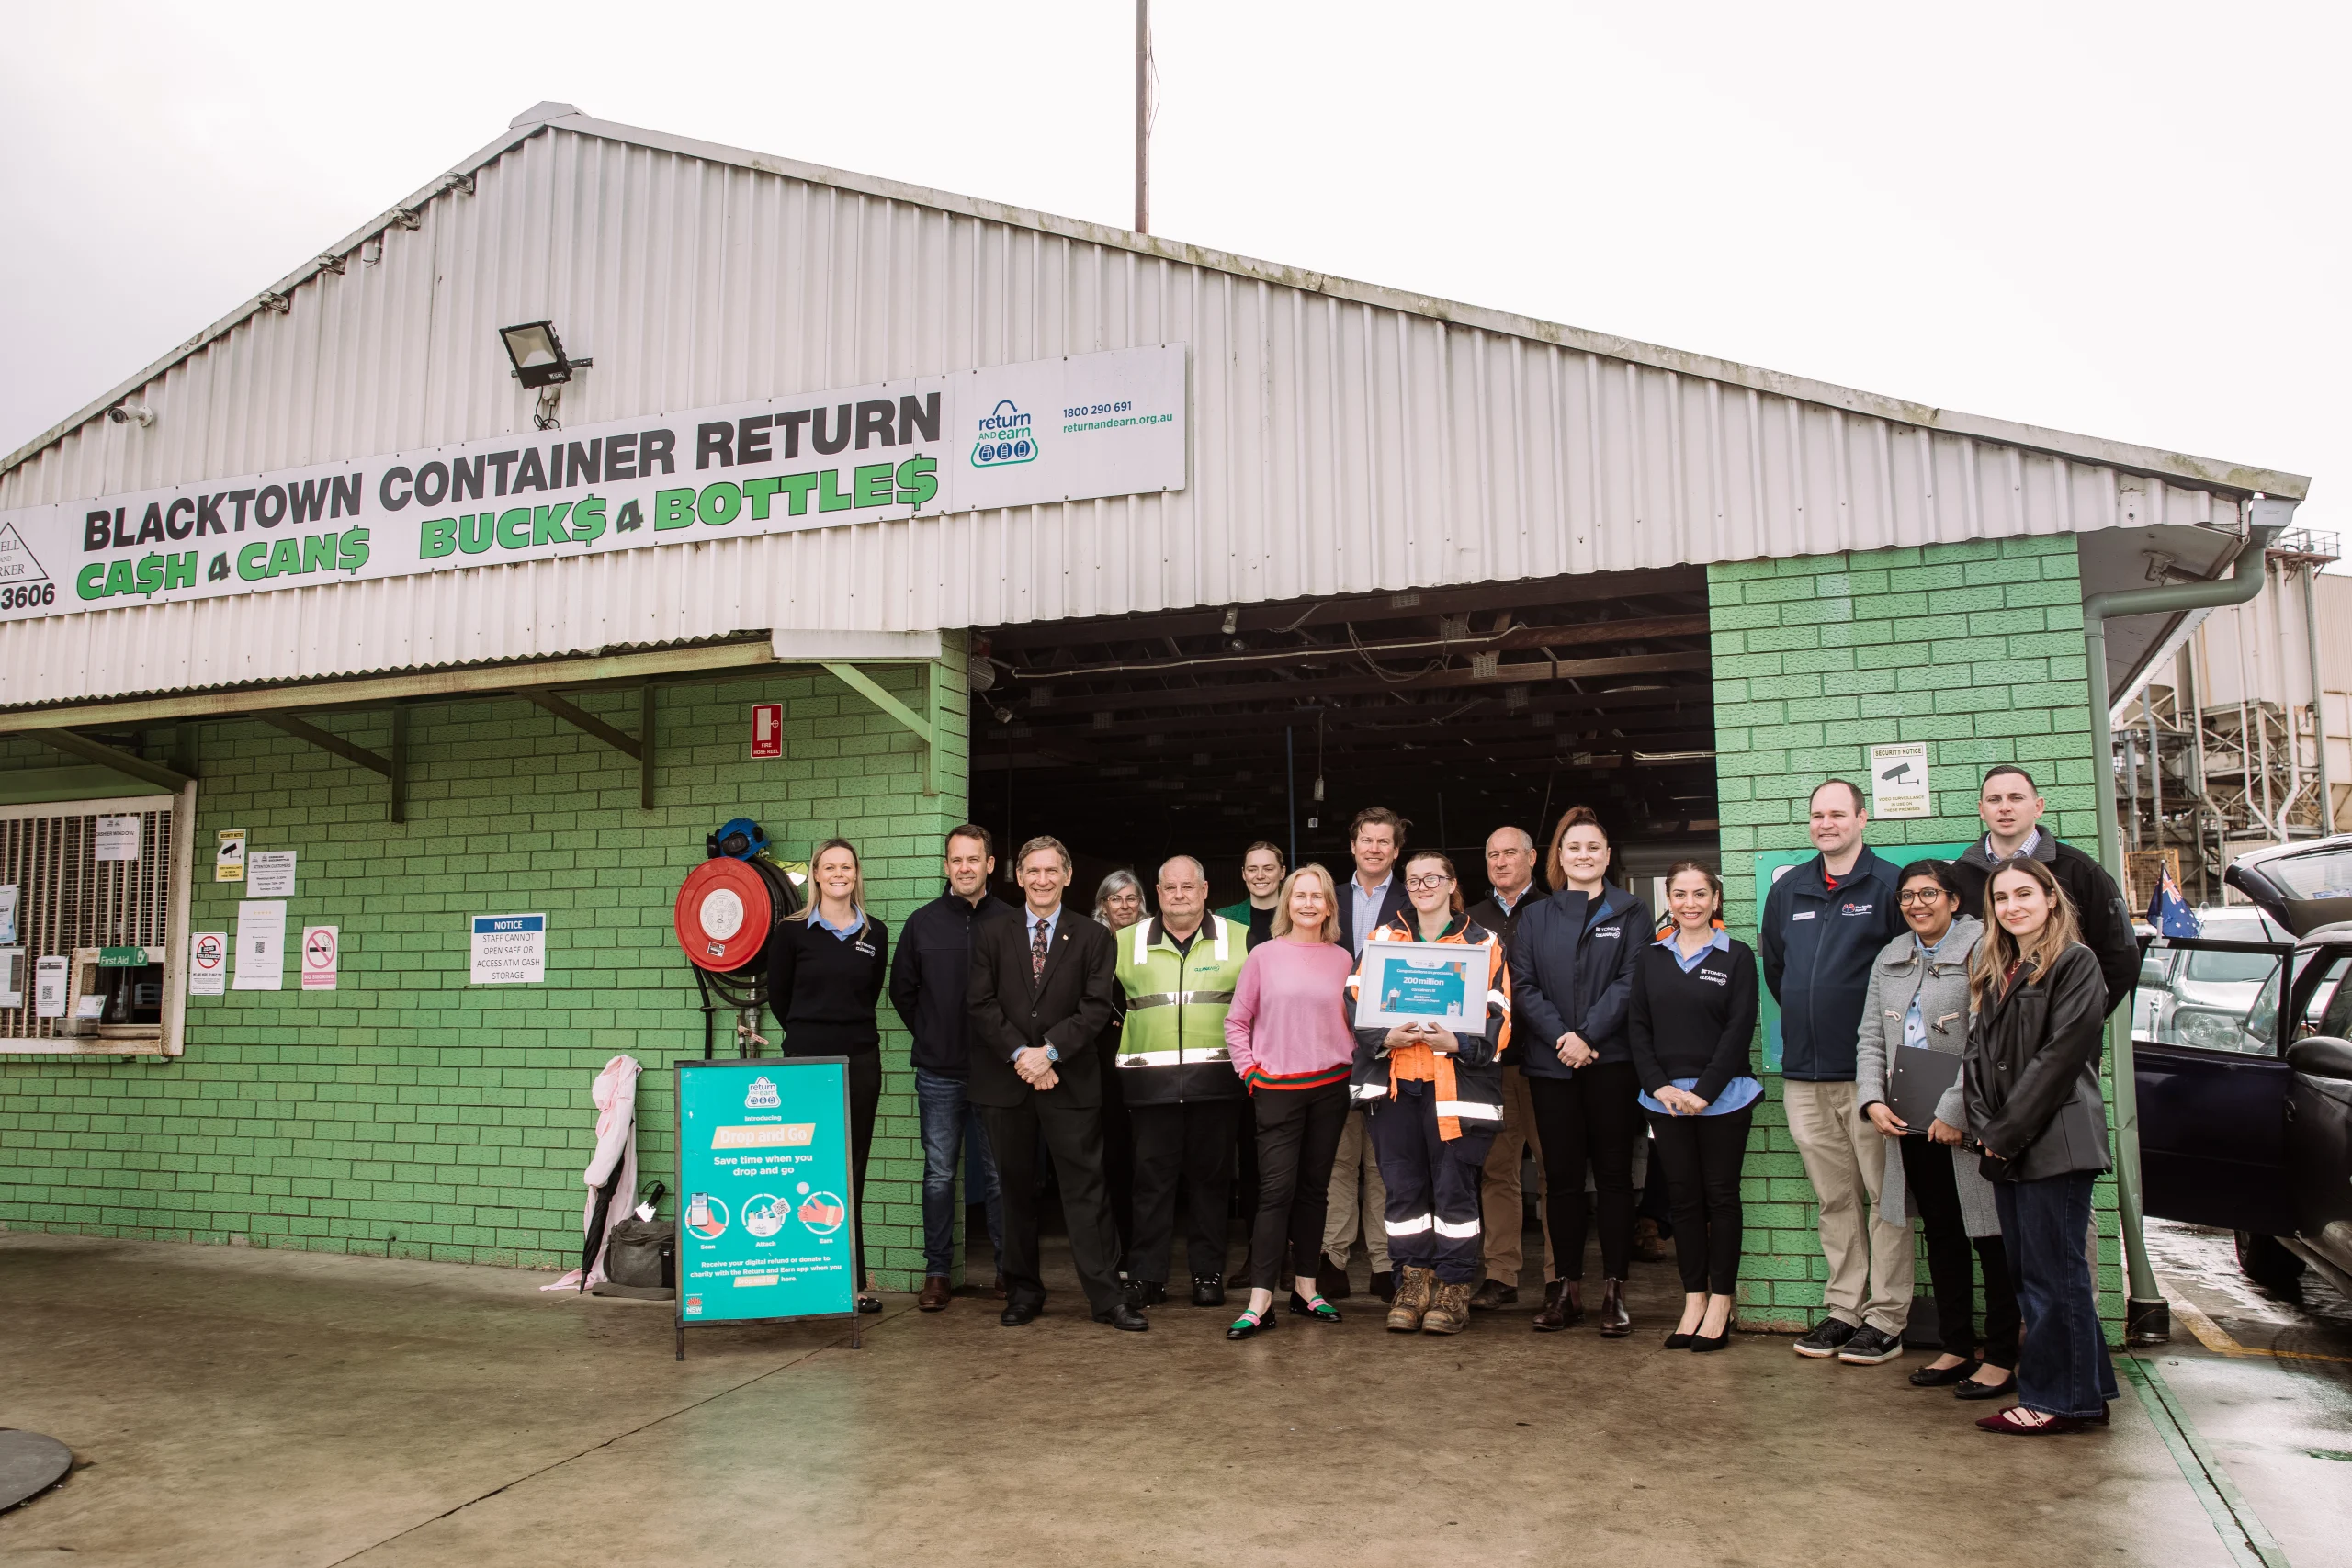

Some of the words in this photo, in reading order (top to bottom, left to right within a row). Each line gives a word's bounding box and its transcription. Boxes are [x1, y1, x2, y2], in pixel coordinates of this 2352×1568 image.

[1063, 407, 1088, 418] 1800
[1091, 403, 1112, 414] 290
[1114, 401, 1132, 412] 691
[978, 413, 1031, 431] return
[1063, 413, 1173, 433] returnandearn.org.au
[978, 432, 997, 440] AND
[998, 426, 1031, 440] earn
[84, 473, 363, 552] BLACKTOWN
[379, 428, 675, 512] CONTAINER
[696, 391, 941, 470] RETURN
[419, 493, 606, 559] BUCK$
[616, 499, 644, 534] 4
[654, 454, 938, 531] BOTTLE$
[76, 551, 198, 600] CA$H
[208, 551, 231, 583] 4
[237, 525, 370, 581] CAN$
[1, 583, 55, 610] 3606
[494, 920, 523, 930] NOTICE
[482, 934, 503, 942] STAFF
[505, 933, 535, 942] CANNOT
[523, 945, 534, 953] OR
[100, 956, 116, 964] First
[117, 955, 129, 964] Aid
[477, 959, 502, 967] ACCESS
[503, 958, 519, 966] ATM
[492, 971, 525, 979] STORAGE
[1419, 977, 1444, 986] million
[720, 1130, 754, 1145] Drop
[758, 1127, 785, 1142] and
[787, 1127, 807, 1141] Go
[714, 1156, 738, 1165] Save
[740, 1156, 763, 1164] time
[765, 1155, 792, 1163] when
[795, 1155, 812, 1163] you
[733, 1168, 757, 1177] drop
[760, 1167, 778, 1175] and
[781, 1167, 794, 1175] go
